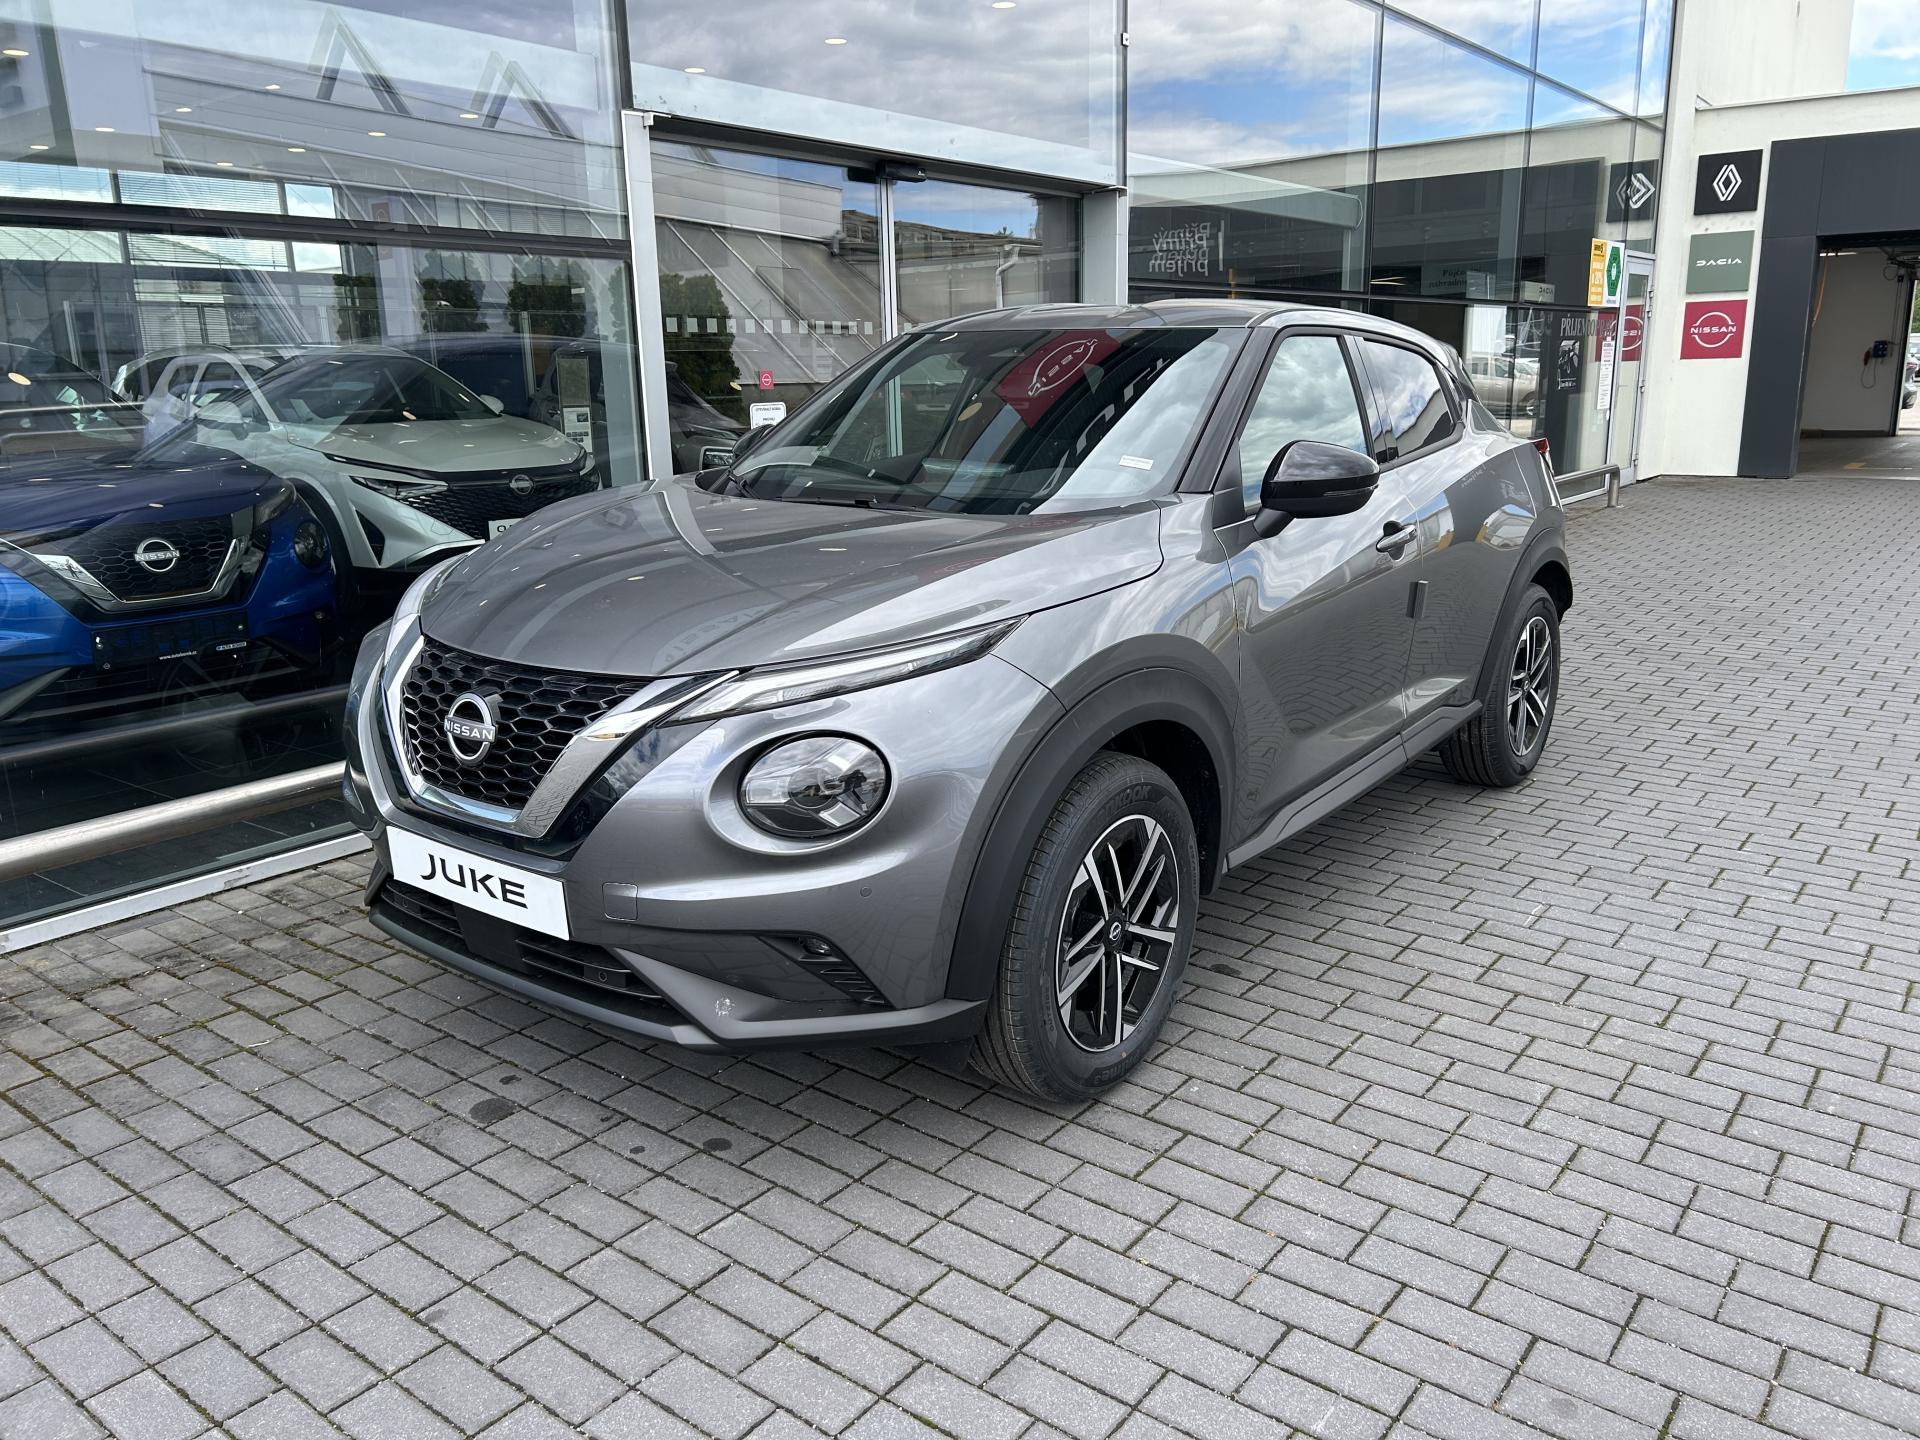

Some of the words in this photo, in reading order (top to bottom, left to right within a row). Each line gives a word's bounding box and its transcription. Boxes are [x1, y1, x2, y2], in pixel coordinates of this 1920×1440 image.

[1696, 258, 1742, 266] DACIA
[1690, 325, 1737, 334] NISSAN
[134, 550, 180, 561] NISSAN
[444, 718, 494, 740] NISSAN
[420, 853, 528, 909] JUKE
